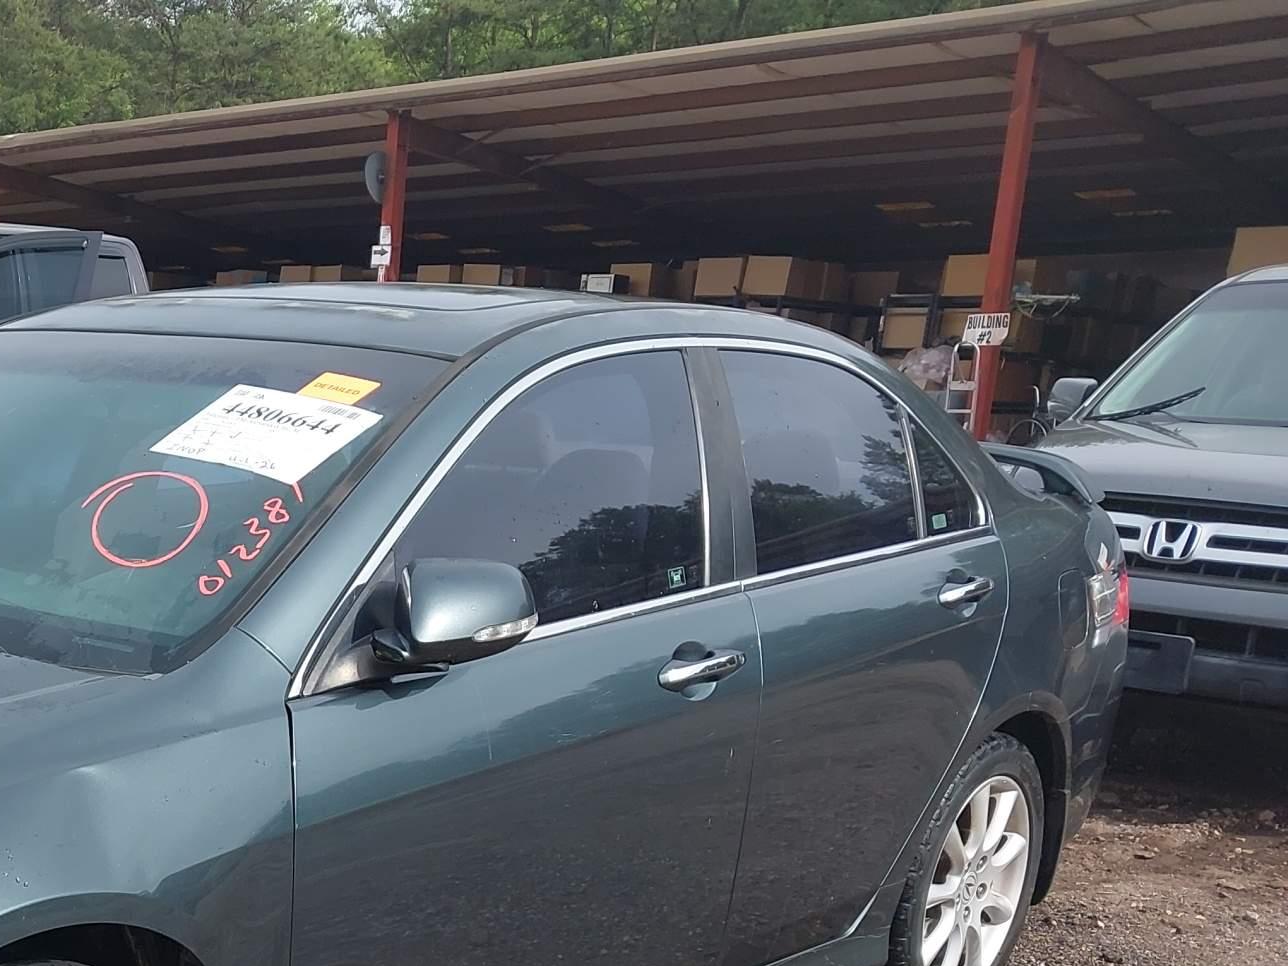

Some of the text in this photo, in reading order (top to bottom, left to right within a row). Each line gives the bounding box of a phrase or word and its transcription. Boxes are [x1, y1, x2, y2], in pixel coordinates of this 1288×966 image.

[967, 314, 1009, 329] BUILDING
[976, 330, 992, 344] #2
[314, 381, 361, 396] DETAILED
[222, 401, 343, 435] 44806644
